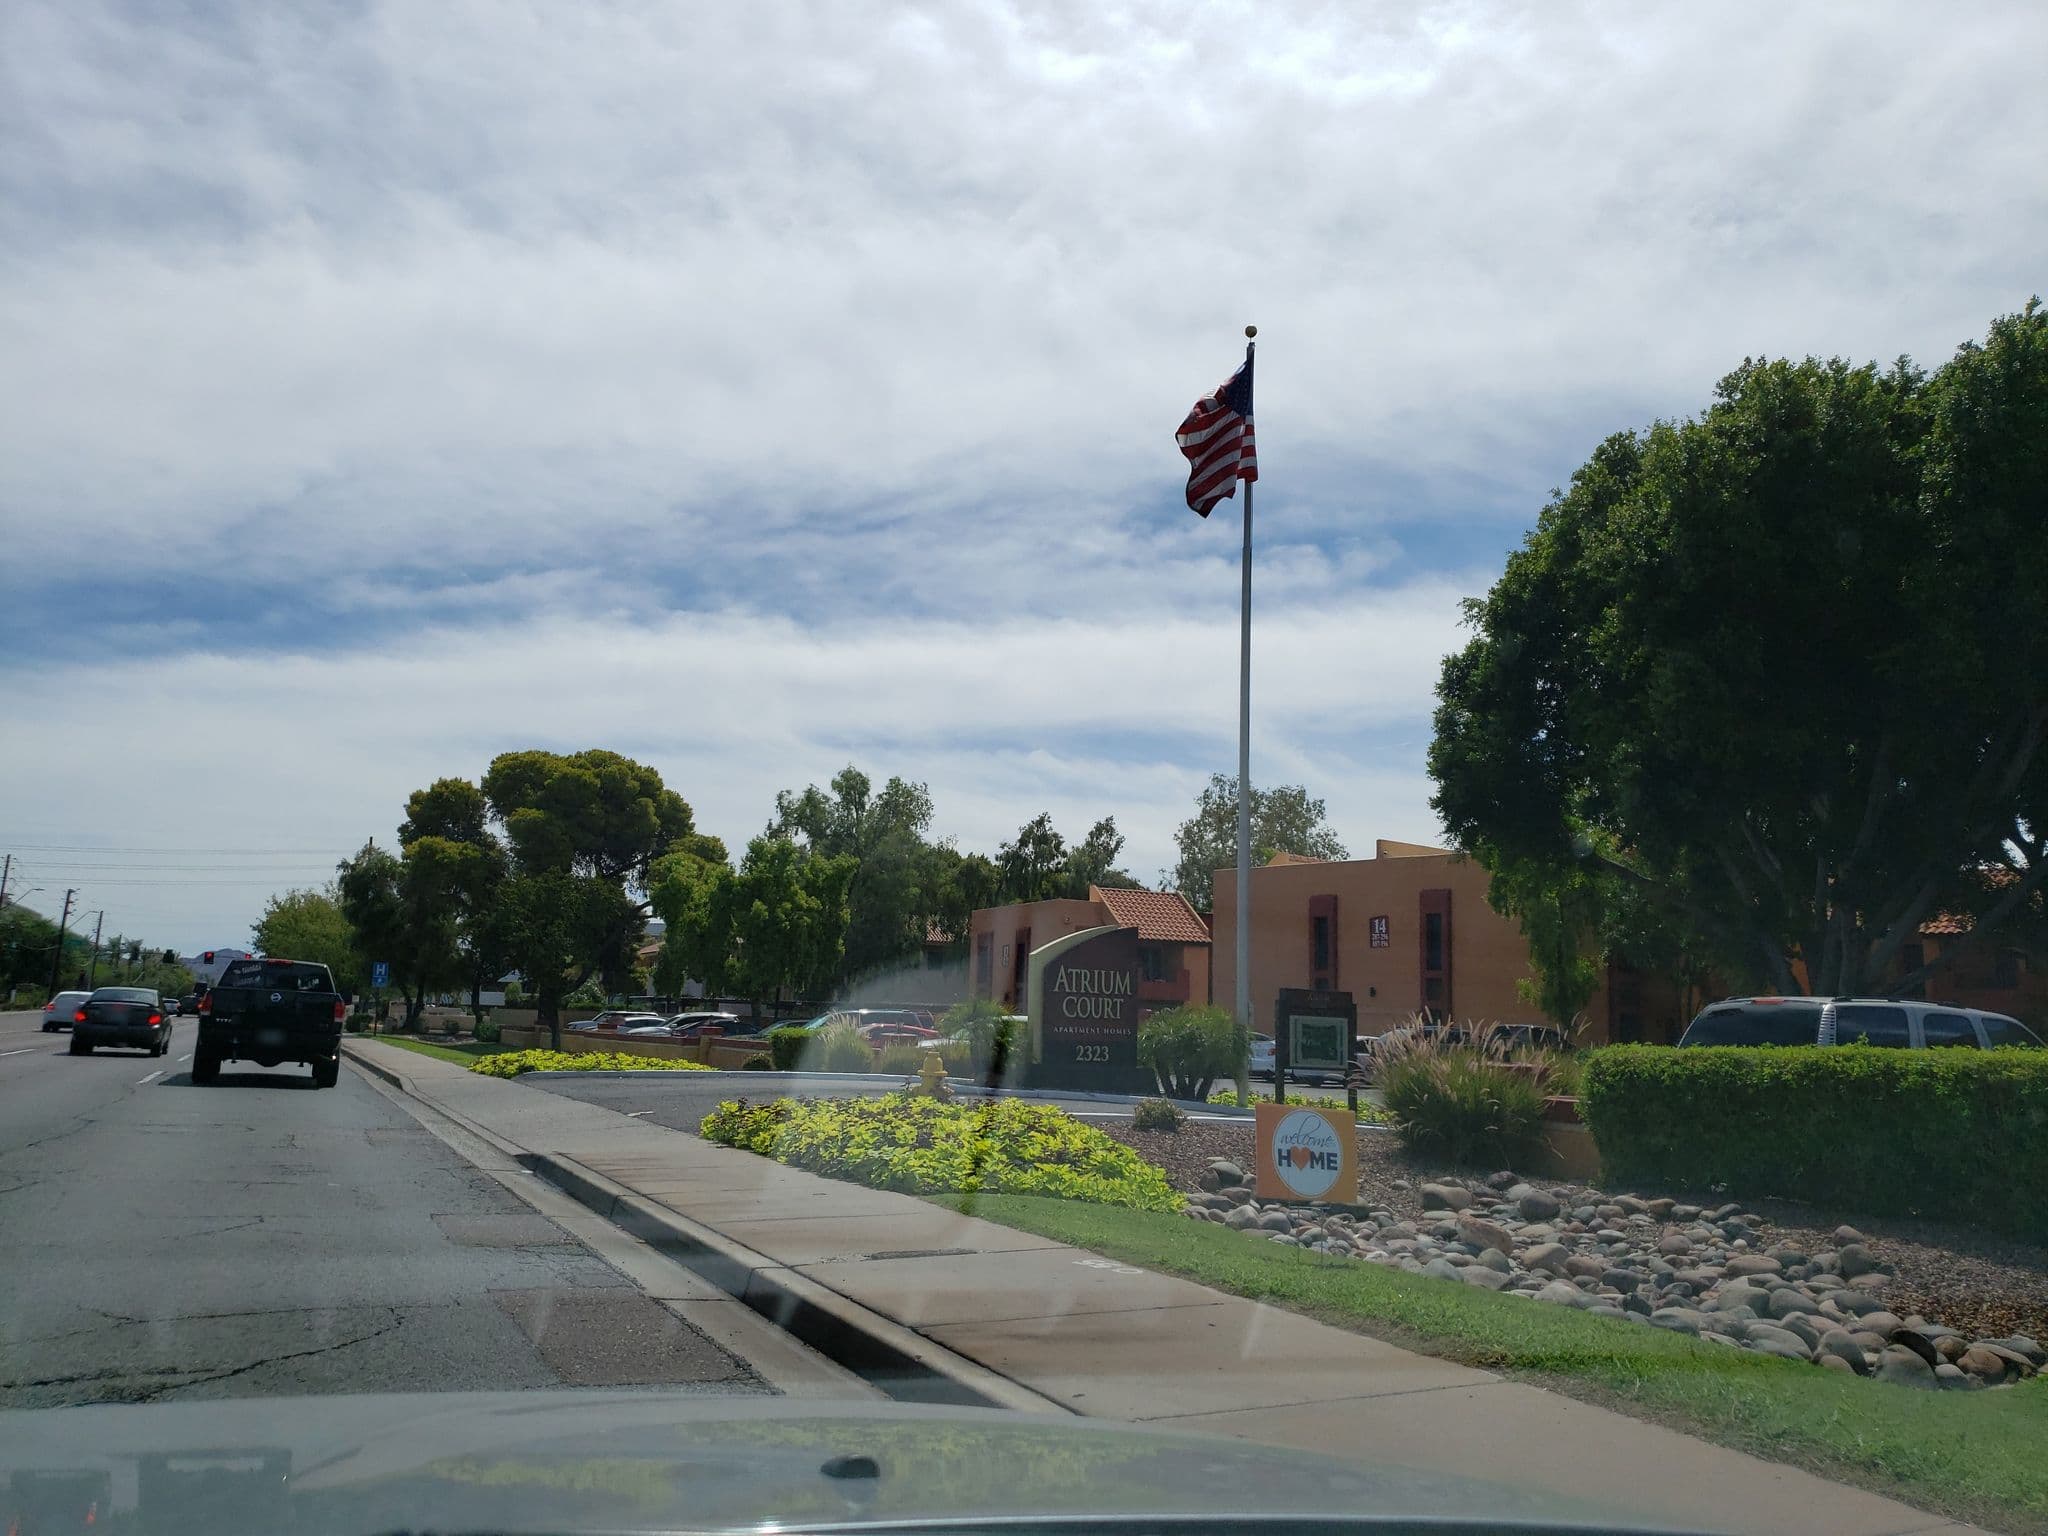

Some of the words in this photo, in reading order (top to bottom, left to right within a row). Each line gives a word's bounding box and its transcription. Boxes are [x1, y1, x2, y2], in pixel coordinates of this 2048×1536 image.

[1374, 918, 1386, 933] 14
[376, 964, 386, 976] H
[1053, 964, 1132, 996] ATRIUM
[1062, 995, 1124, 1019] COURT
[1075, 1045, 1109, 1062] 2323
